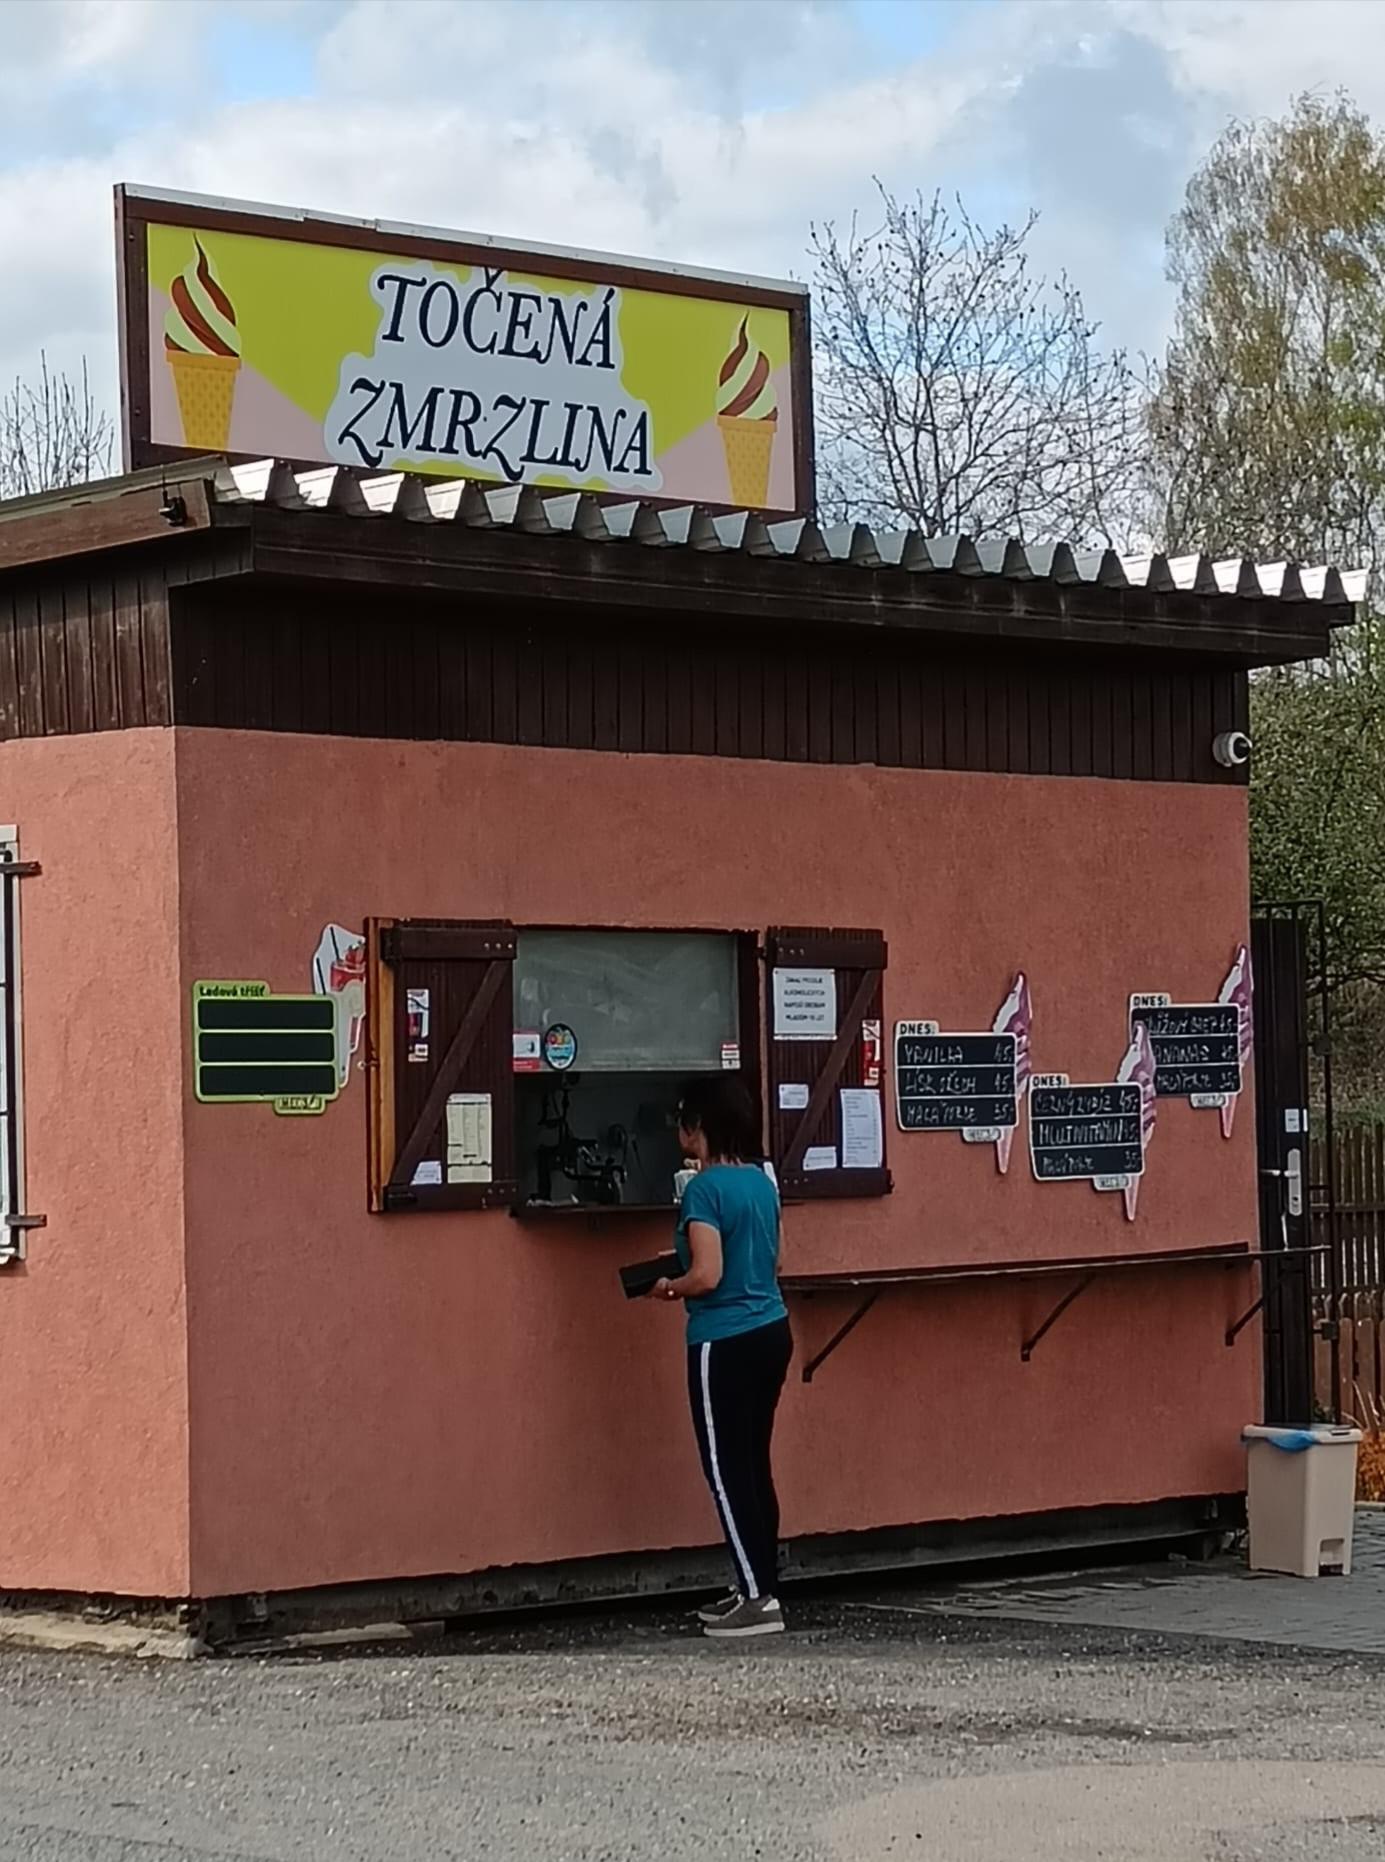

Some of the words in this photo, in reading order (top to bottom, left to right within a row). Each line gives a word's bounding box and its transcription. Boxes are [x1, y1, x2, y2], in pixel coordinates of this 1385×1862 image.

[377, 267, 616, 370] TOČENÁ
[338, 377, 653, 482] ZMRZLINA
[1132, 995, 1168, 1007] DNES:
[899, 1022, 936, 1035] DNES:
[1032, 1075, 1067, 1087] DNES:
